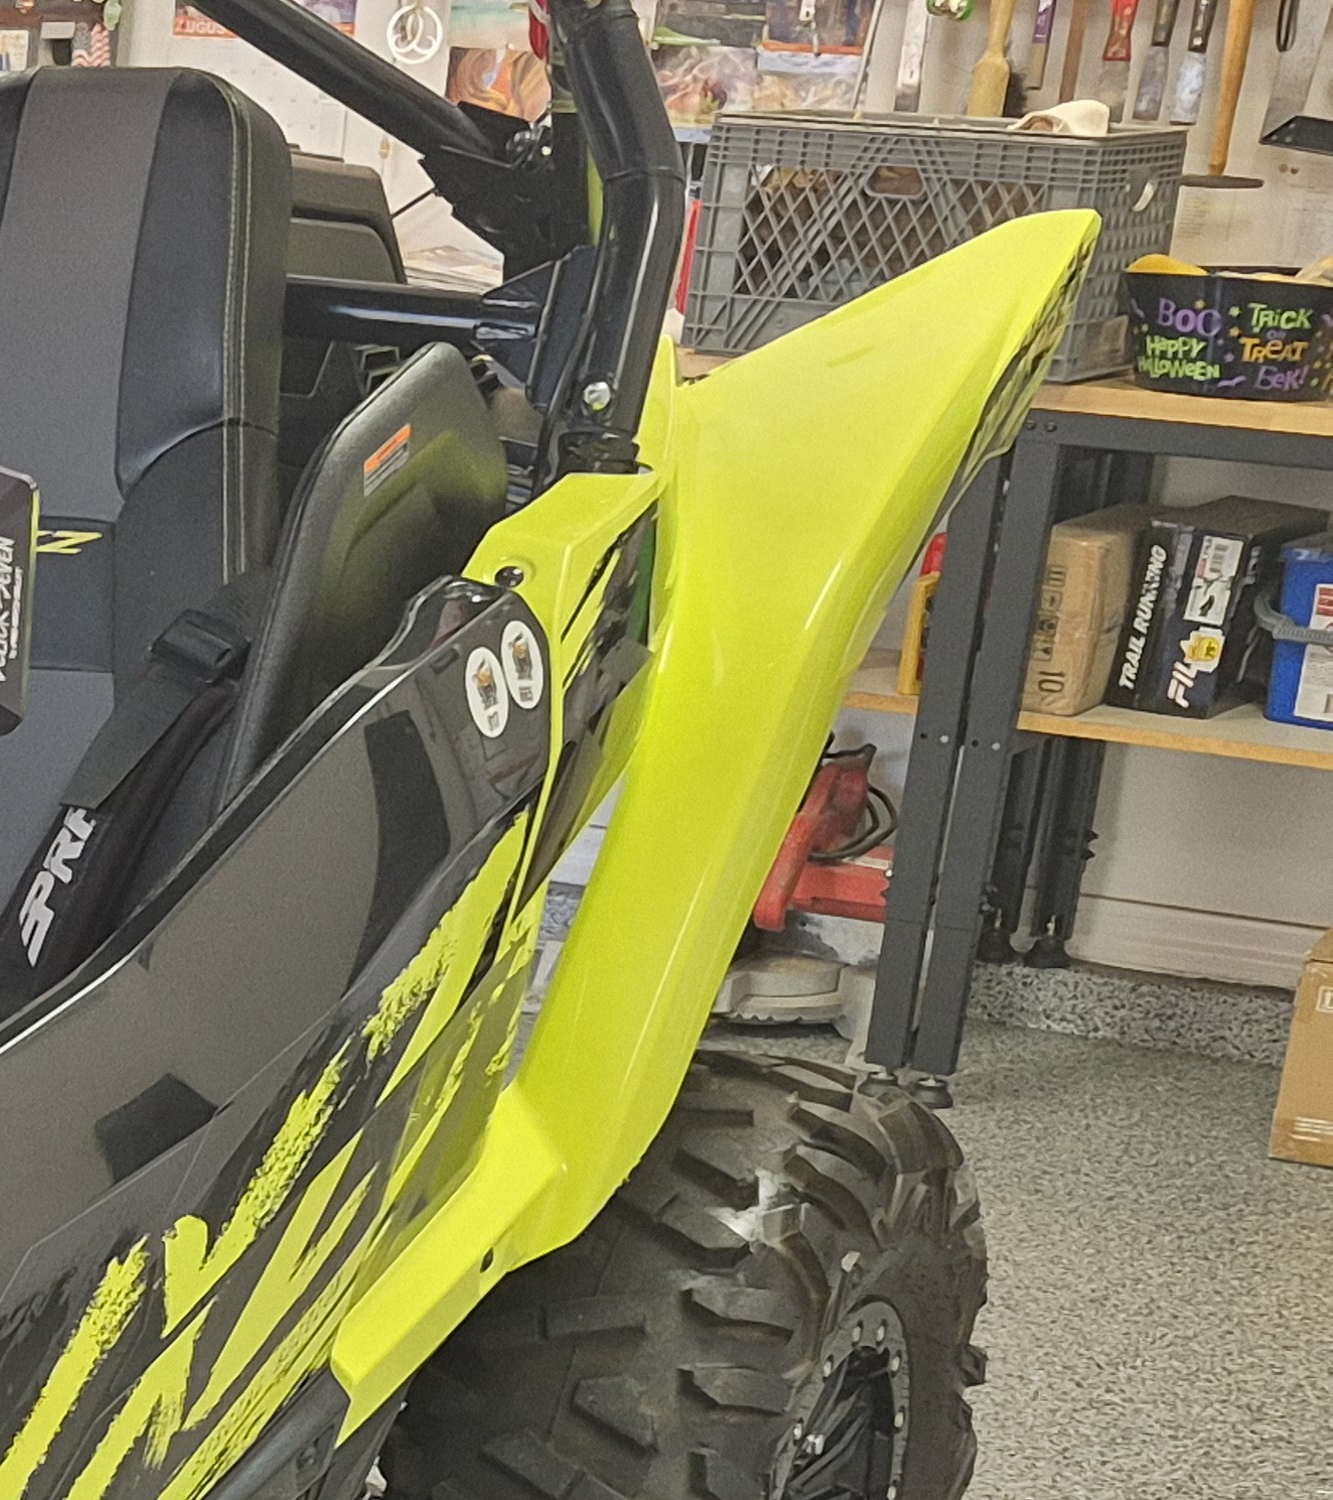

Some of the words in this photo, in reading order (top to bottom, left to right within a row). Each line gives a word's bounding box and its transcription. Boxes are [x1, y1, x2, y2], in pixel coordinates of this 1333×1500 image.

[1119, 635, 1146, 690] TRAIL
[1133, 544, 1167, 634] RUNNING
[1166, 660, 1198, 709] FIL
